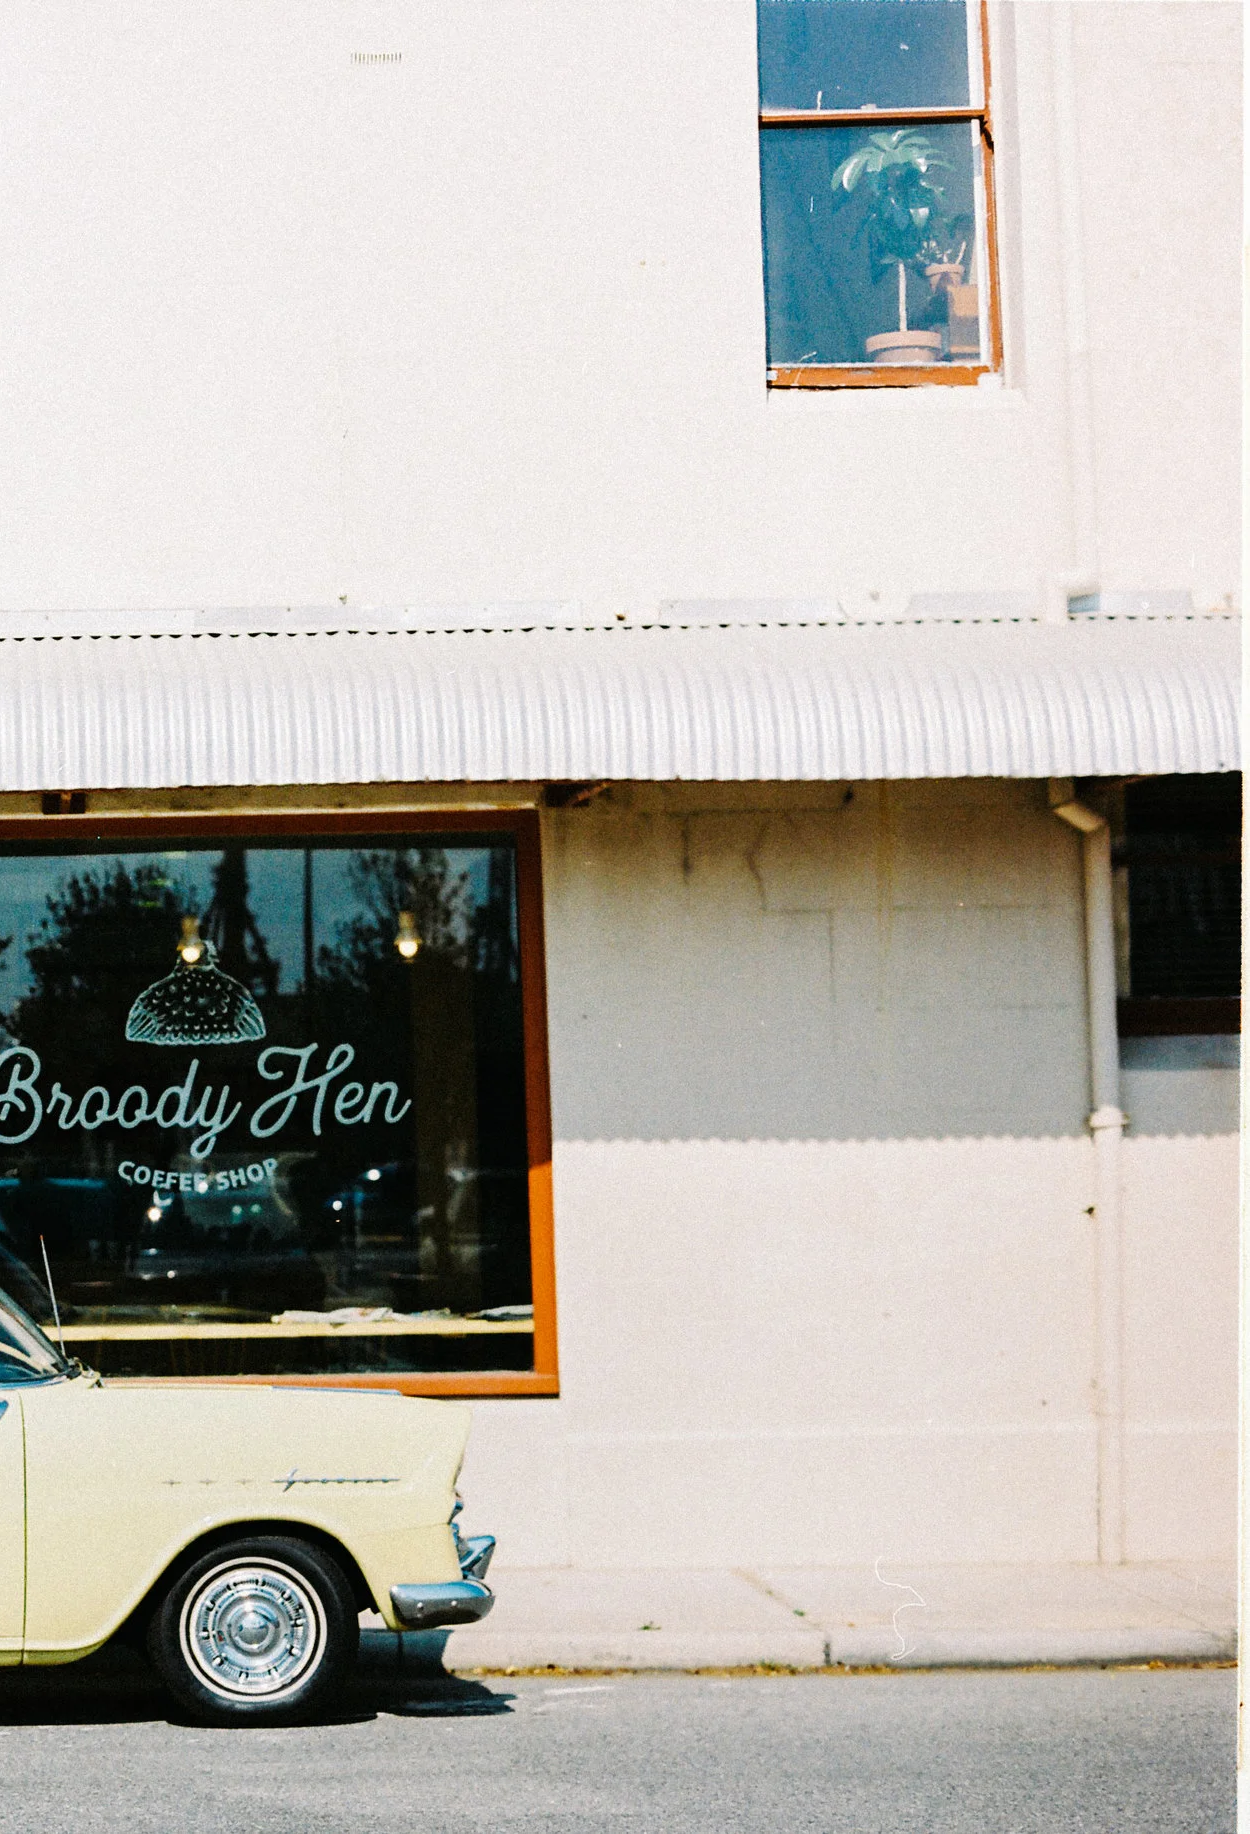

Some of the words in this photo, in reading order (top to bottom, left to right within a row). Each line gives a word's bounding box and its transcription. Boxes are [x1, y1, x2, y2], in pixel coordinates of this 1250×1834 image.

[250, 1042, 412, 1136] Hen
[117, 1161, 209, 1192] COFFEE
[215, 1158, 278, 1191] SHOP
